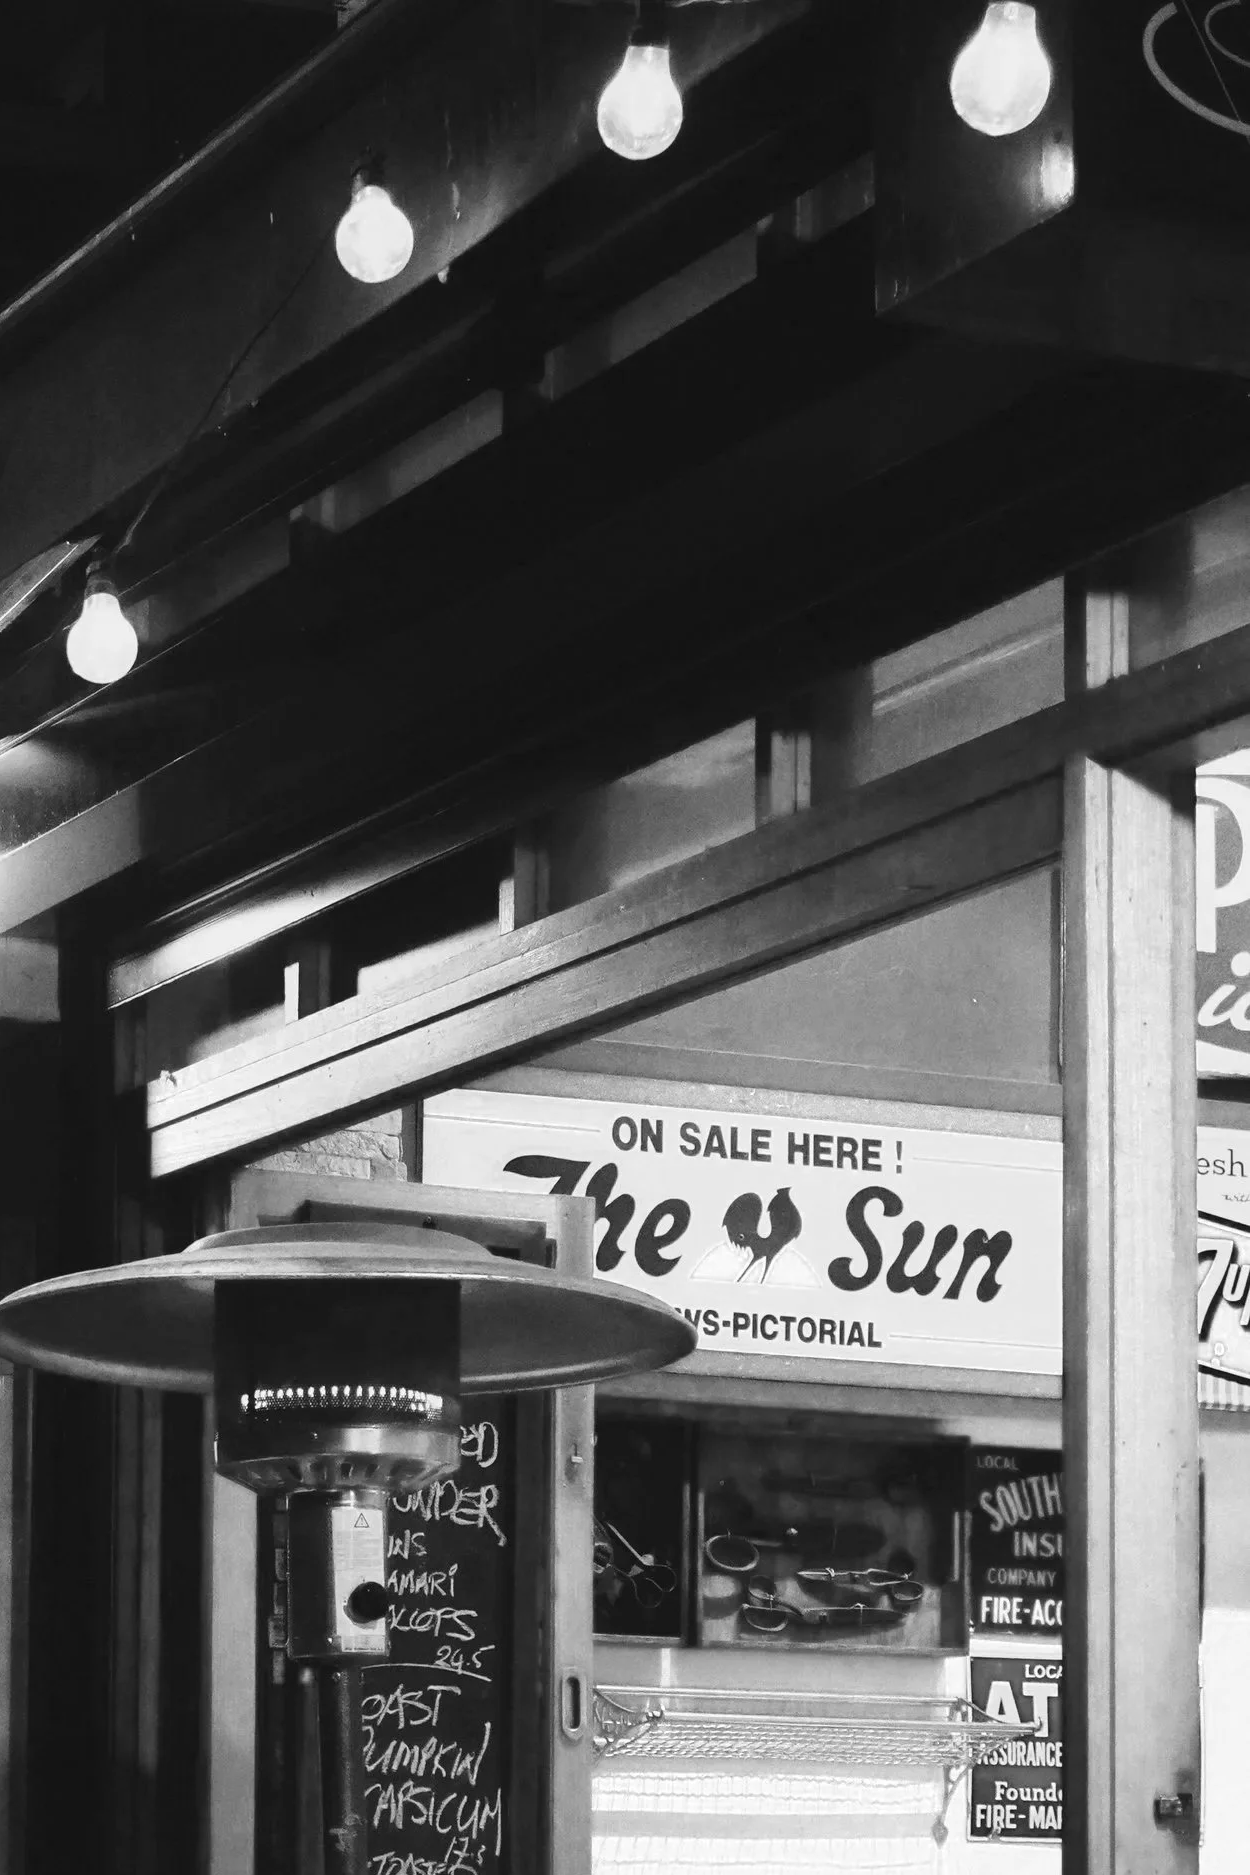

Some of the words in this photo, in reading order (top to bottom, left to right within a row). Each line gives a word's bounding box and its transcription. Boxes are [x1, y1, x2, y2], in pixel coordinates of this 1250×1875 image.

[611, 1115, 664, 1154] ON
[679, 1122, 772, 1163] SALE
[787, 1132, 882, 1171] HERE
[502, 1153, 691, 1277] The
[827, 1185, 1013, 1303] Sun
[976, 1455, 1019, 1471] LOCAL
[987, 1567, 1057, 1587] COMPANY
